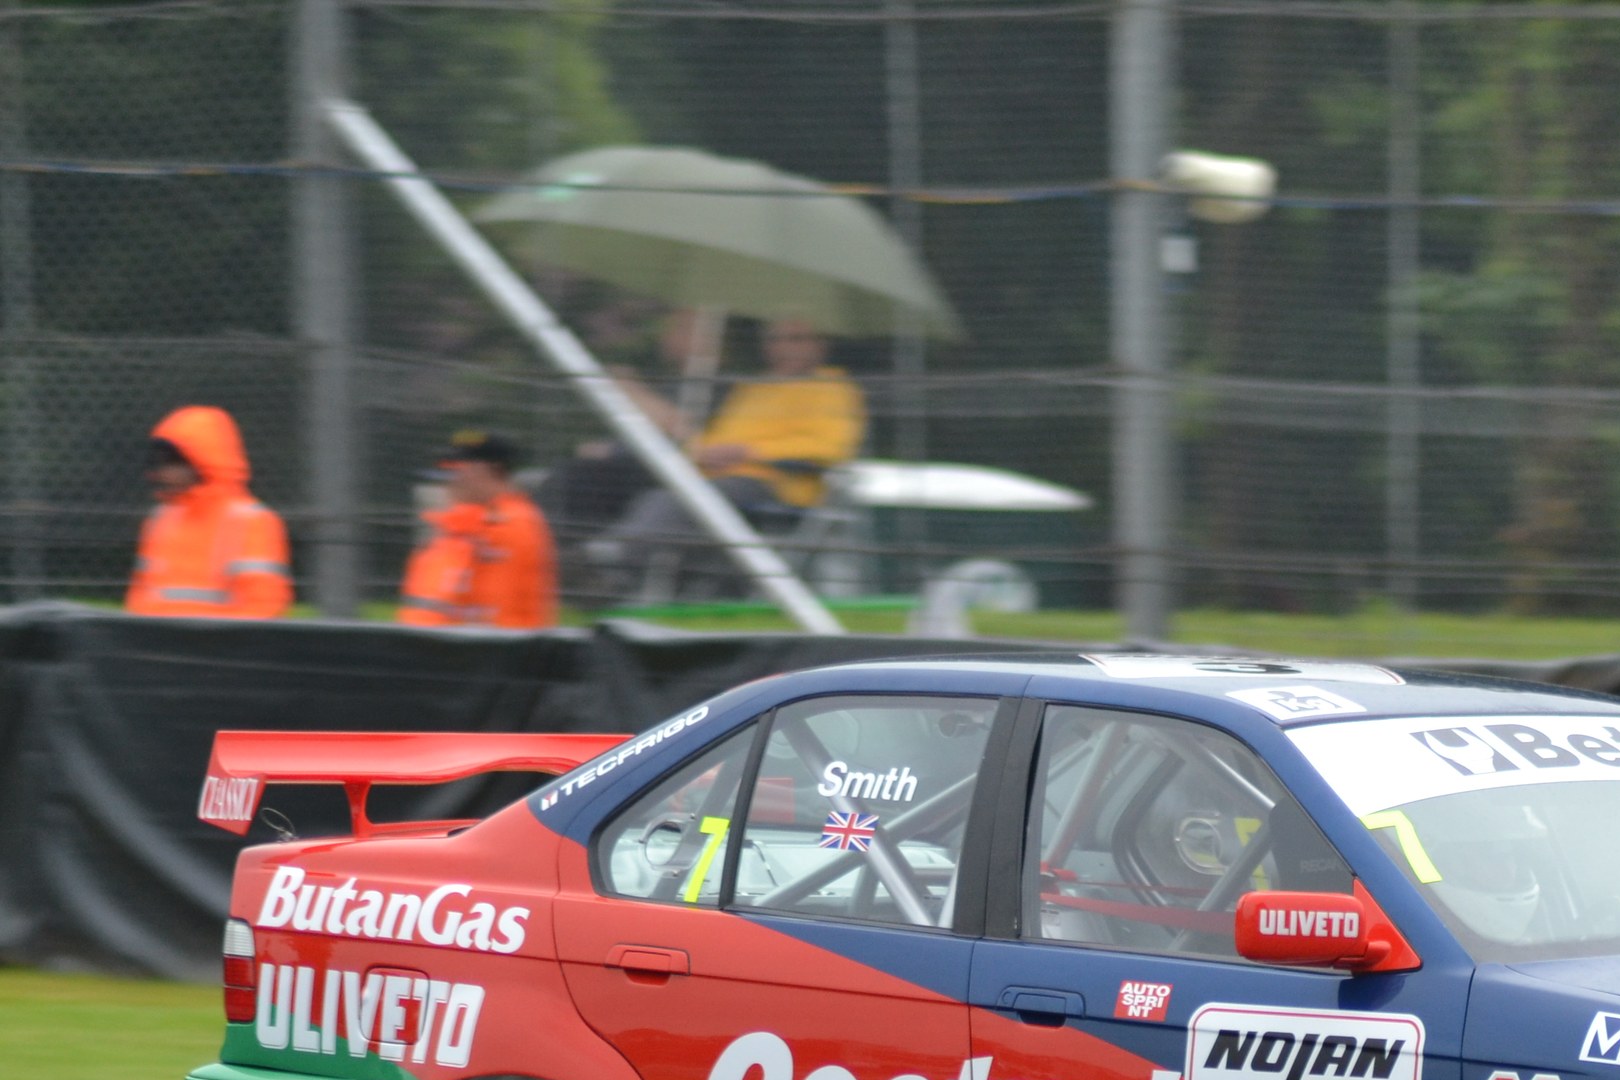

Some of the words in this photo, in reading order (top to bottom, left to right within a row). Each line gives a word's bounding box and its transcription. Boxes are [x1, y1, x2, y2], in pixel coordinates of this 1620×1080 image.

[560, 706, 709, 796] TECFRIGO
[818, 760, 918, 802] Smith
[683, 816, 731, 902] 7
[1360, 810, 1443, 884] 7
[257, 865, 531, 953] ButanGas
[1259, 909, 1360, 938] ULIVETO
[256, 962, 486, 1068] ULIVETO
[1120, 982, 1171, 998] AUTO
[1121, 993, 1165, 1008] SPRI
[1128, 1005, 1153, 1018] NT
